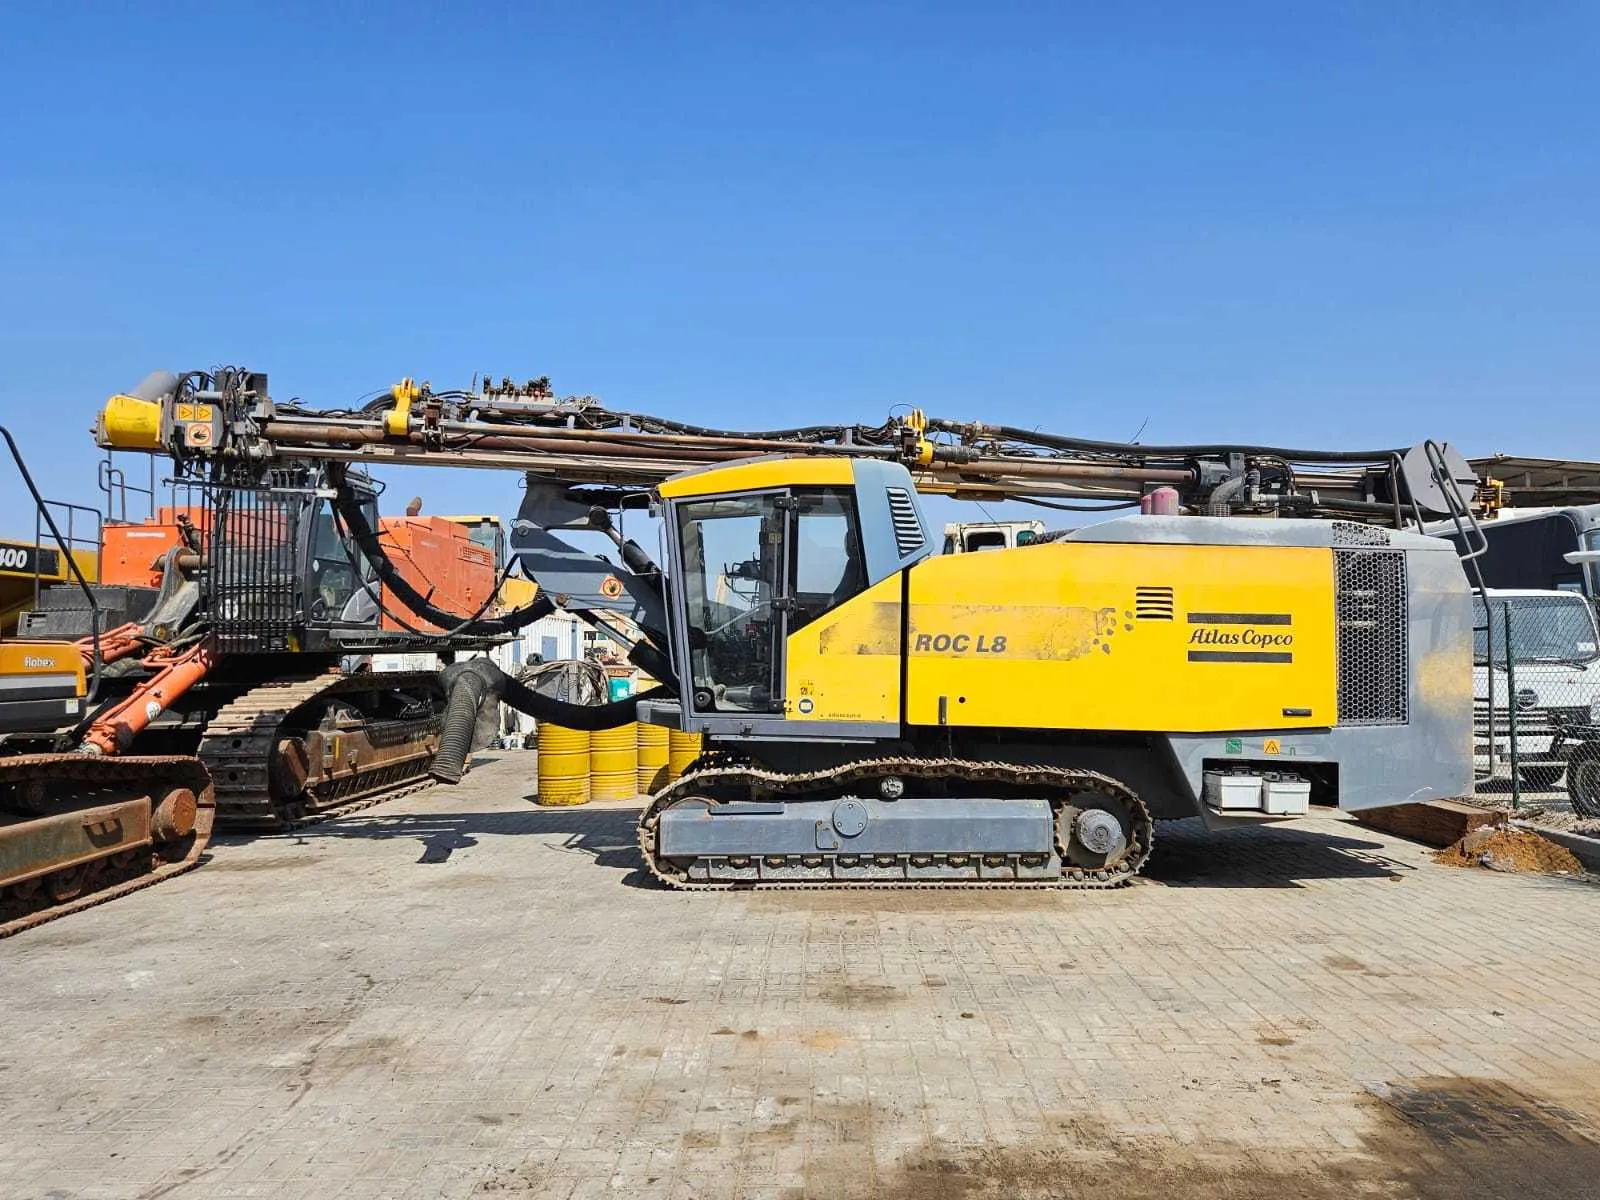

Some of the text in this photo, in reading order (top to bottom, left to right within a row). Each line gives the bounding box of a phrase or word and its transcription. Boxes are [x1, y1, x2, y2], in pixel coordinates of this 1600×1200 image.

[914, 633, 1008, 653] ROC L8
[1188, 628, 1293, 649] Atlas Copco
